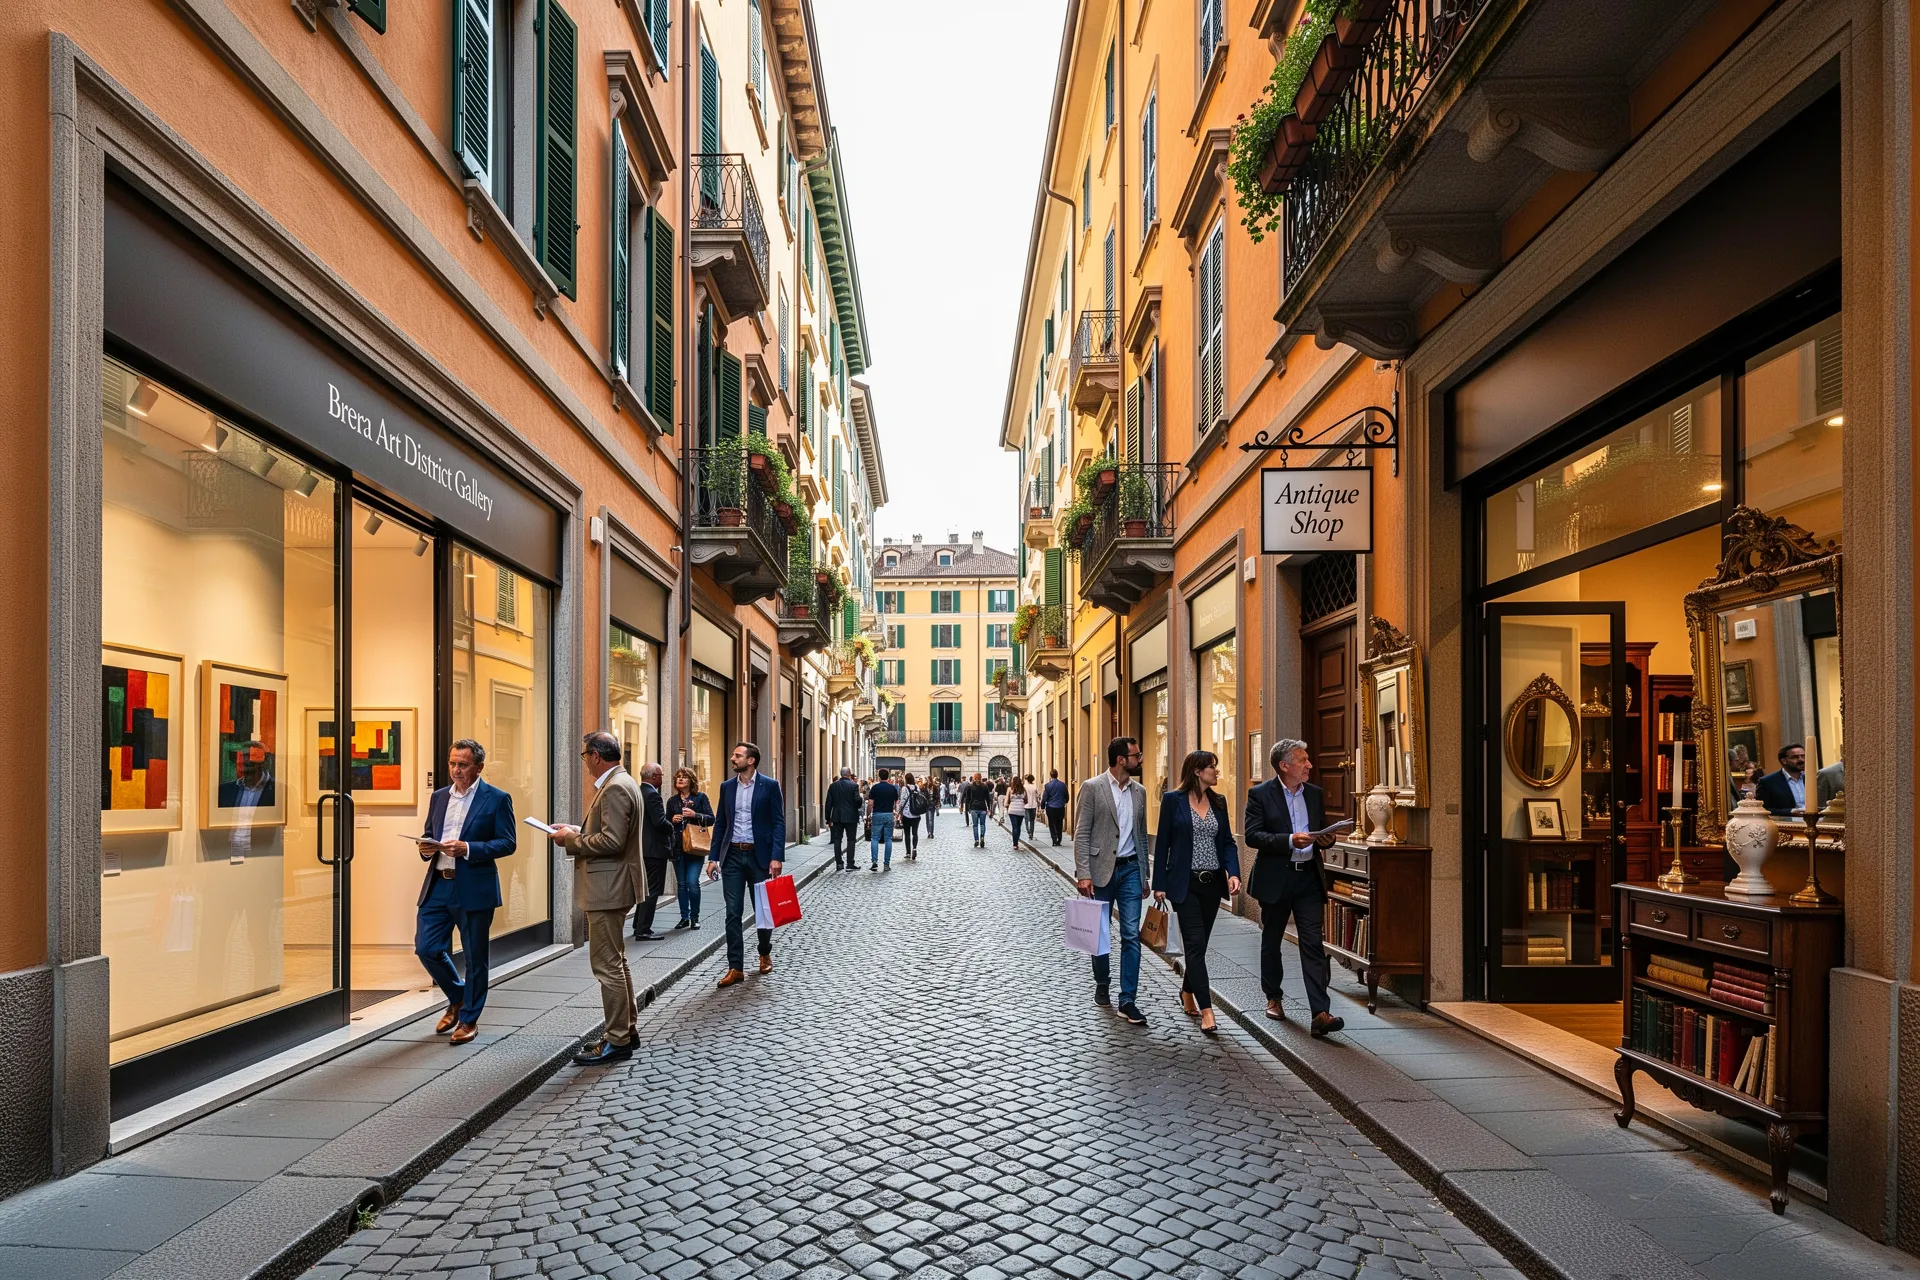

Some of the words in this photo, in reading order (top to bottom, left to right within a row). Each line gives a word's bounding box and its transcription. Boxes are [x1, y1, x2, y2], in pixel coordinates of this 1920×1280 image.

[328, 382, 373, 441] Brera
[376, 418, 401, 459] Art
[404, 434, 452, 491] District
[455, 470, 493, 521] Gallery
[1274, 482, 1359, 513] Antique
[1290, 510, 1344, 541] Shop
